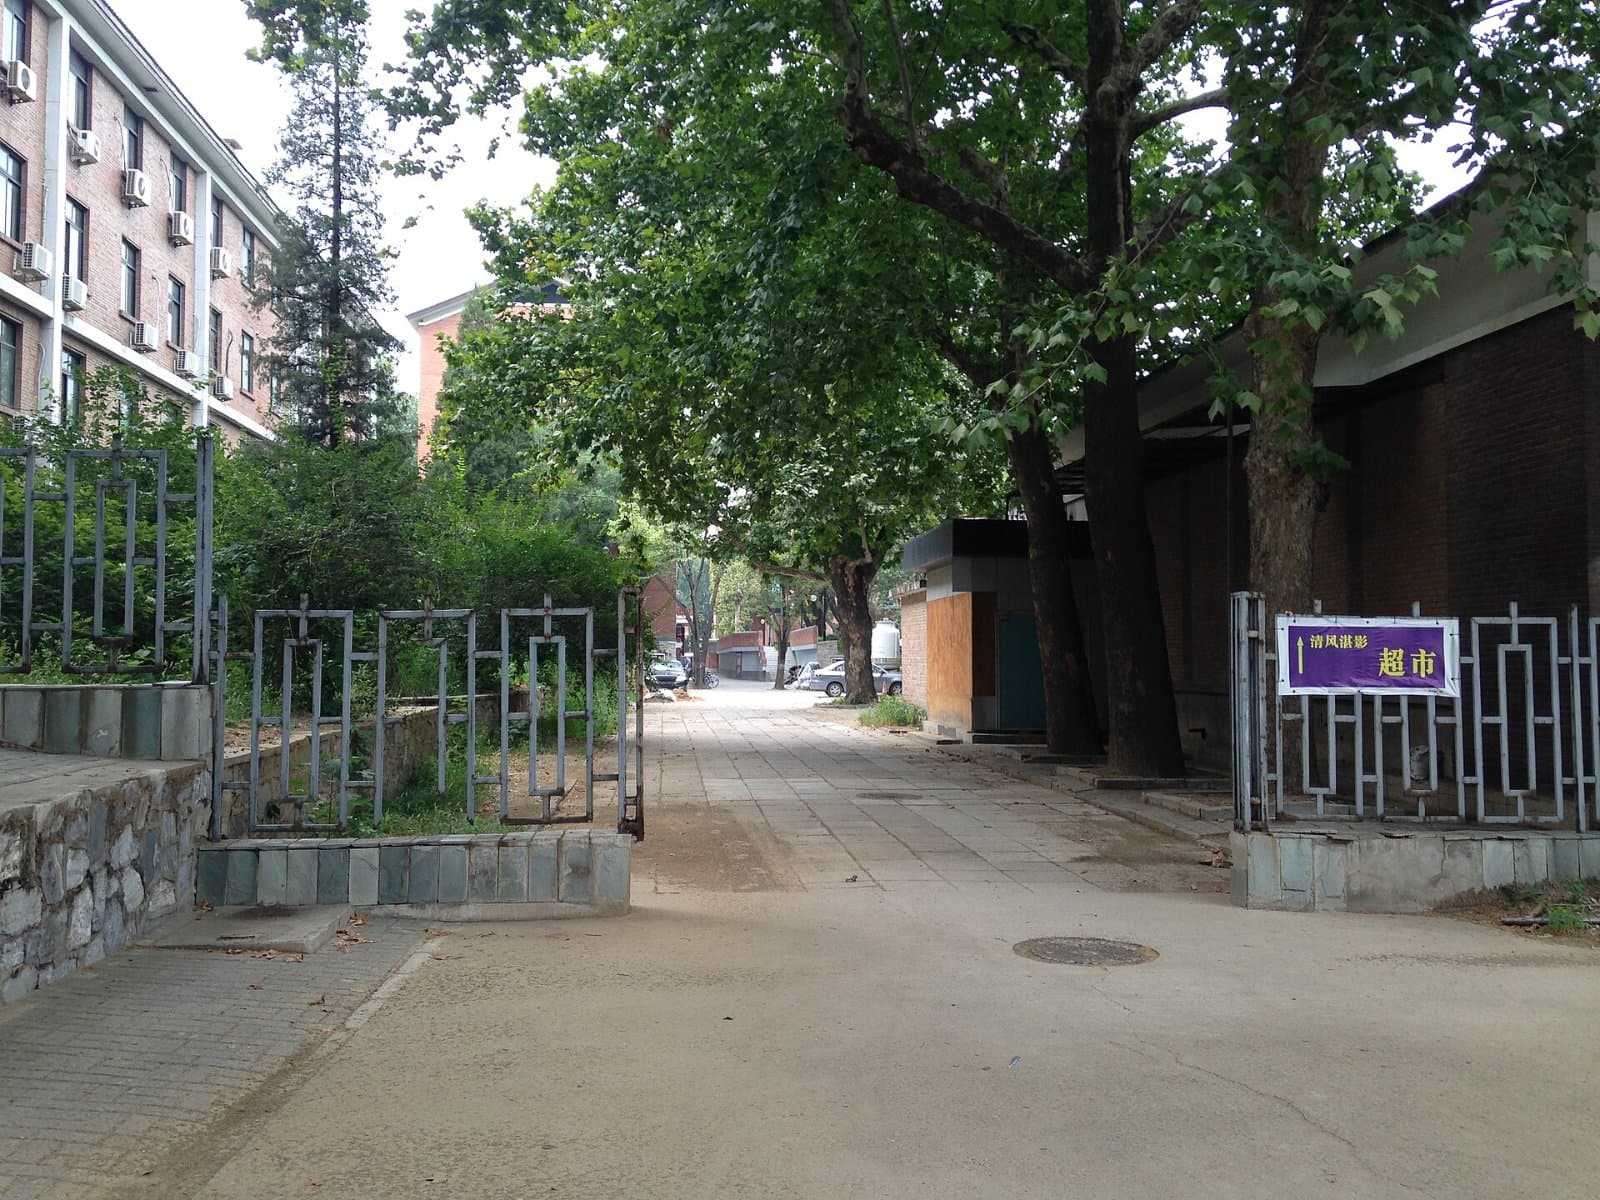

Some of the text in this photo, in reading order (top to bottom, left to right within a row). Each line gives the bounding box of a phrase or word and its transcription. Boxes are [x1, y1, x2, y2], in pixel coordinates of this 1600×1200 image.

[1310, 634, 1368, 649] 清风湛影
[1378, 647, 1437, 679] 超市
